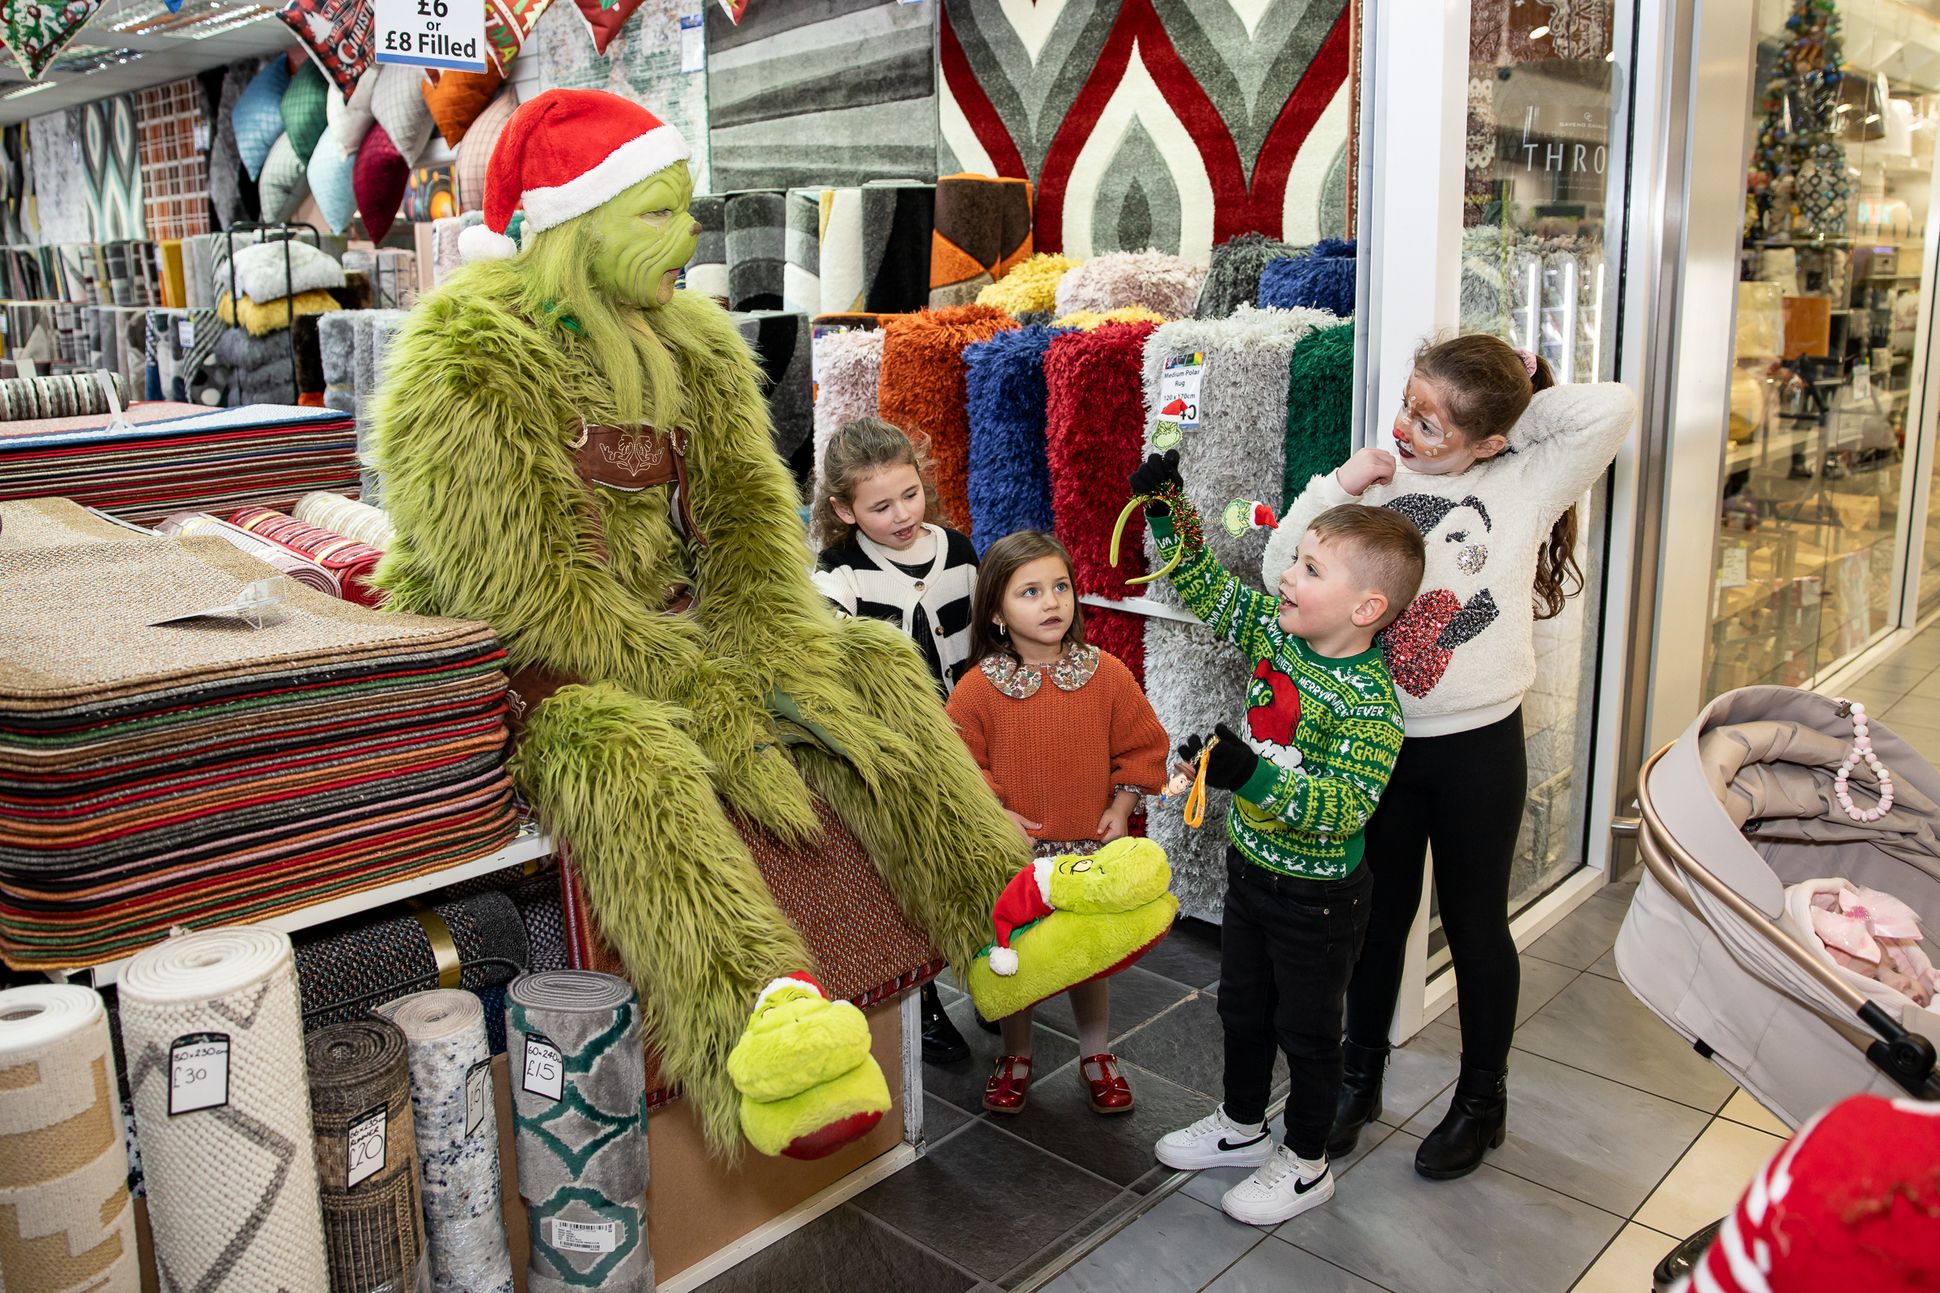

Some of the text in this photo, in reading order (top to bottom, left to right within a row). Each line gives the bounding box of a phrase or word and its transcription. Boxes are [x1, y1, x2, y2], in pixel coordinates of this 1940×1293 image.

[417, 0, 449, 18] £6
[426, 21, 442, 32] or
[385, 30, 412, 52] £8
[418, 33, 477, 58] Filled
[1164, 369, 1200, 379] Medium Polar
[1174, 380, 1186, 388] Rug
[173, 1066, 207, 1088] £30
[526, 1059, 555, 1081] £15
[348, 1134, 384, 1173] £20
